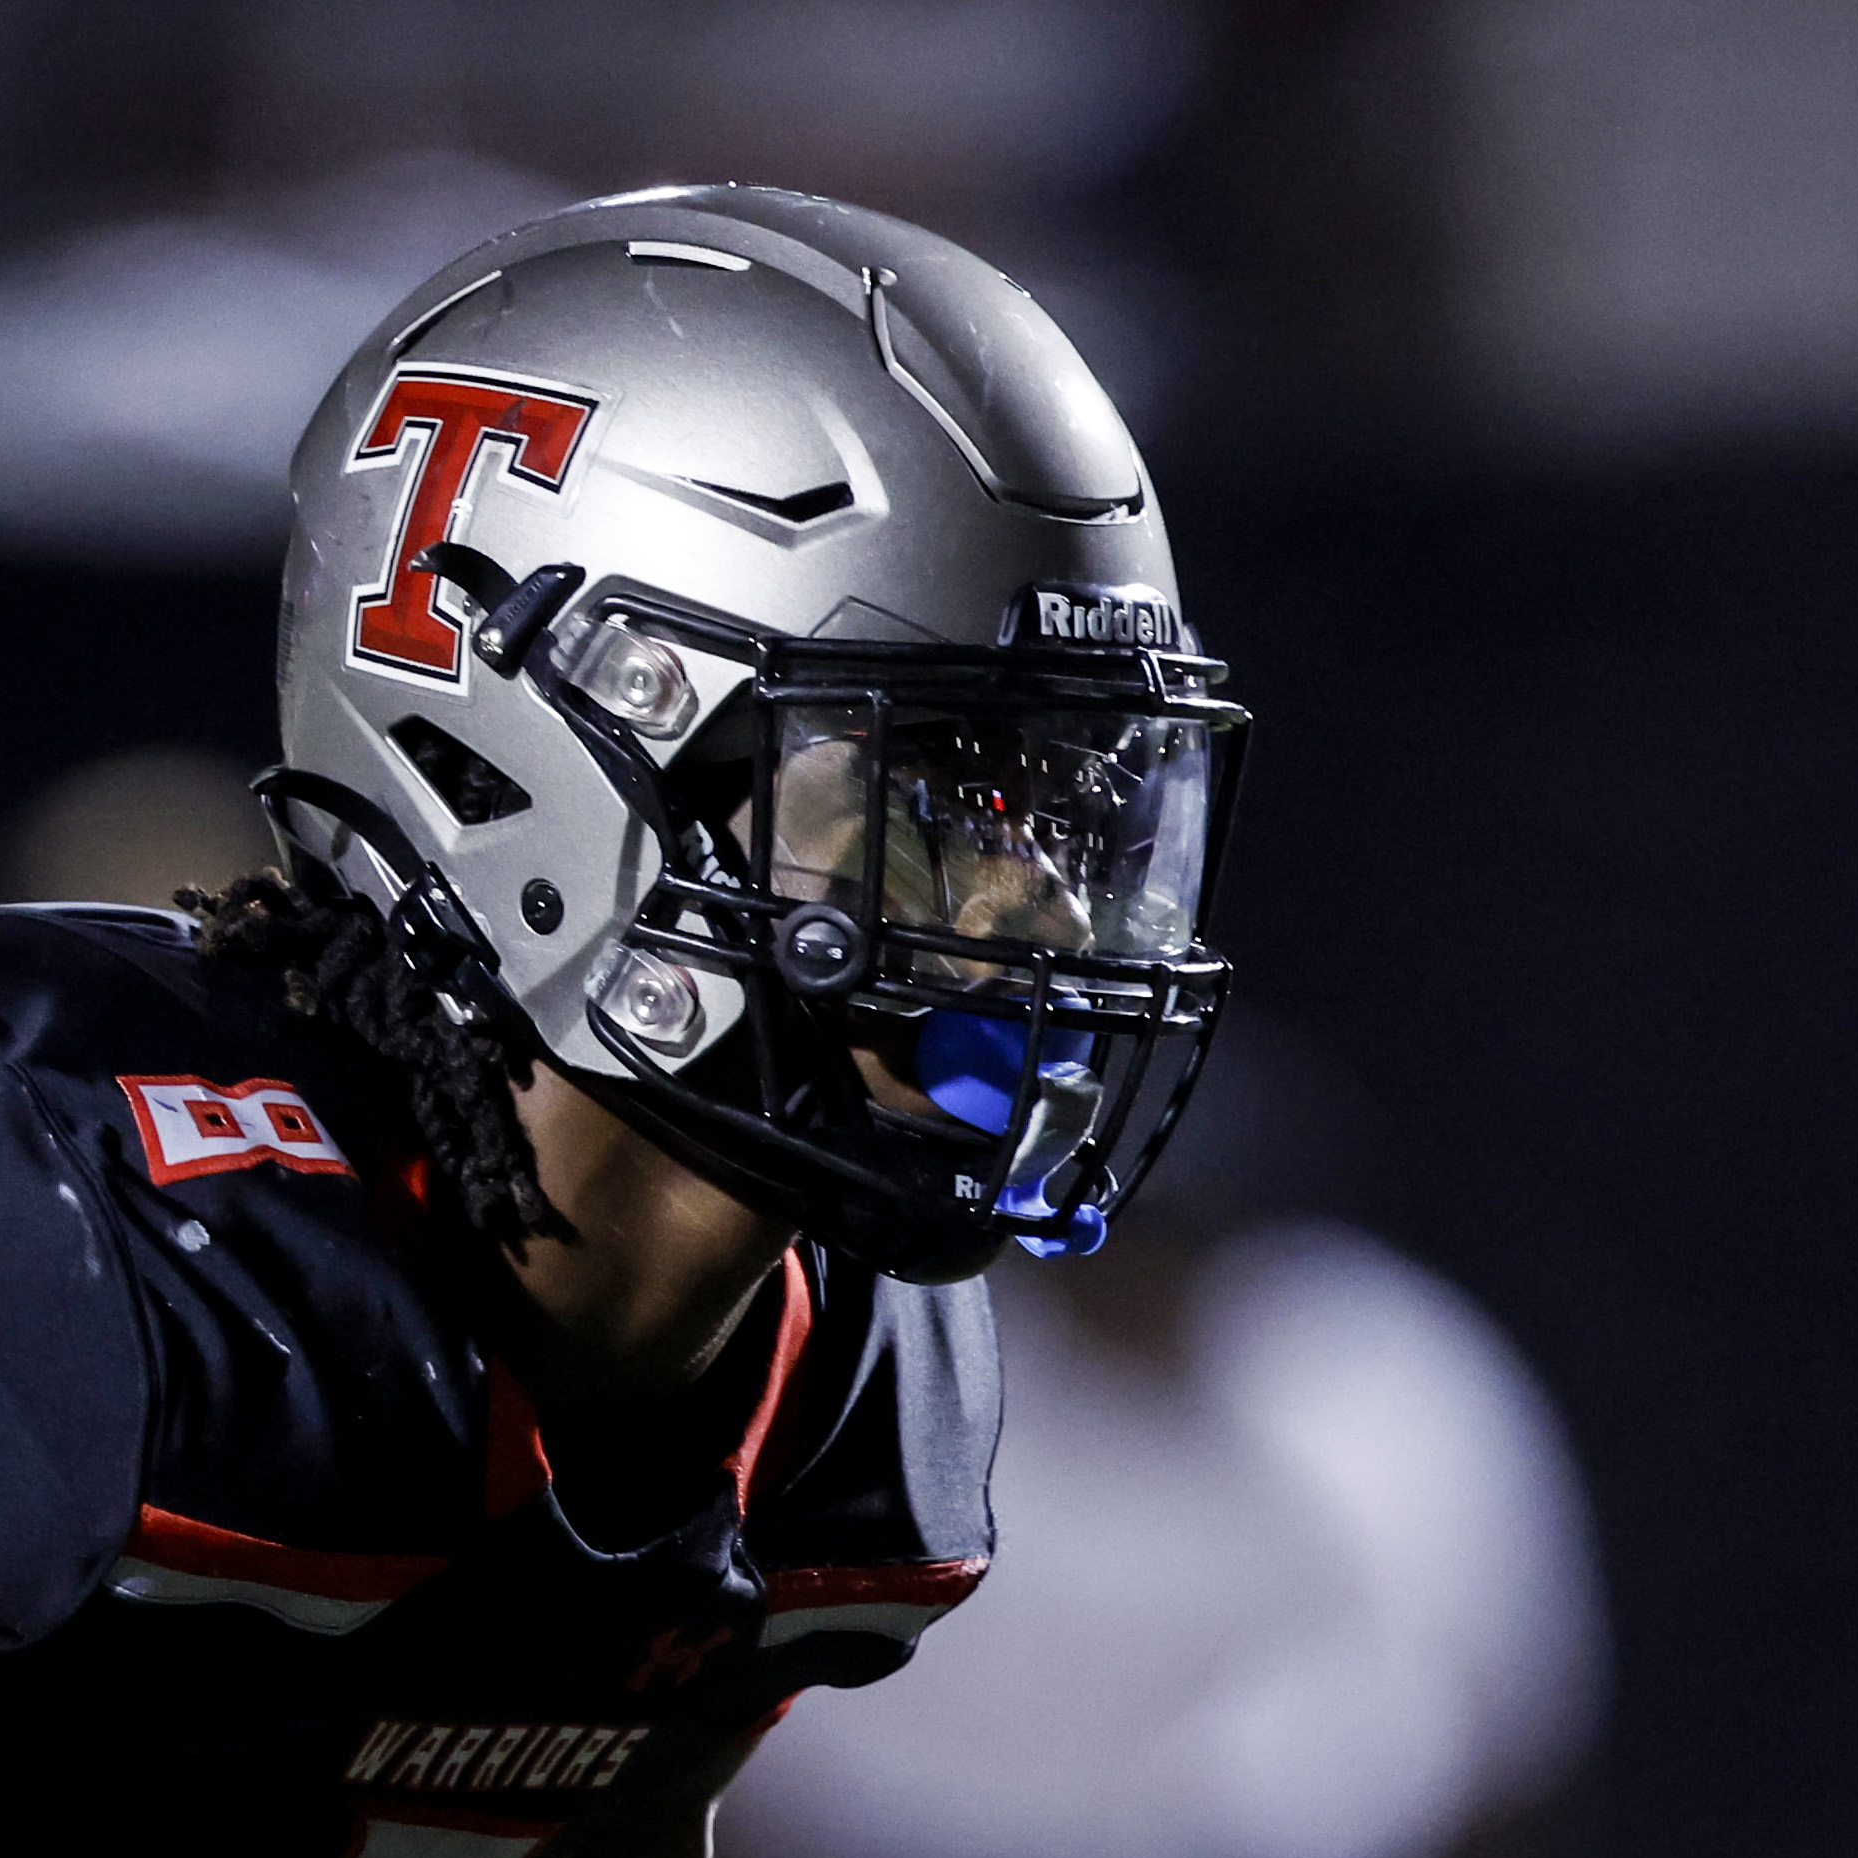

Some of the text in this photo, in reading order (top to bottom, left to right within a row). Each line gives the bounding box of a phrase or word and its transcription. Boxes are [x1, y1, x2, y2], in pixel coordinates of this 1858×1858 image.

[344, 362, 599, 696] T
[1037, 590, 1173, 646] Riddell
[115, 1072, 362, 1188] 8
[343, 1718, 651, 1792] WARRIORS
